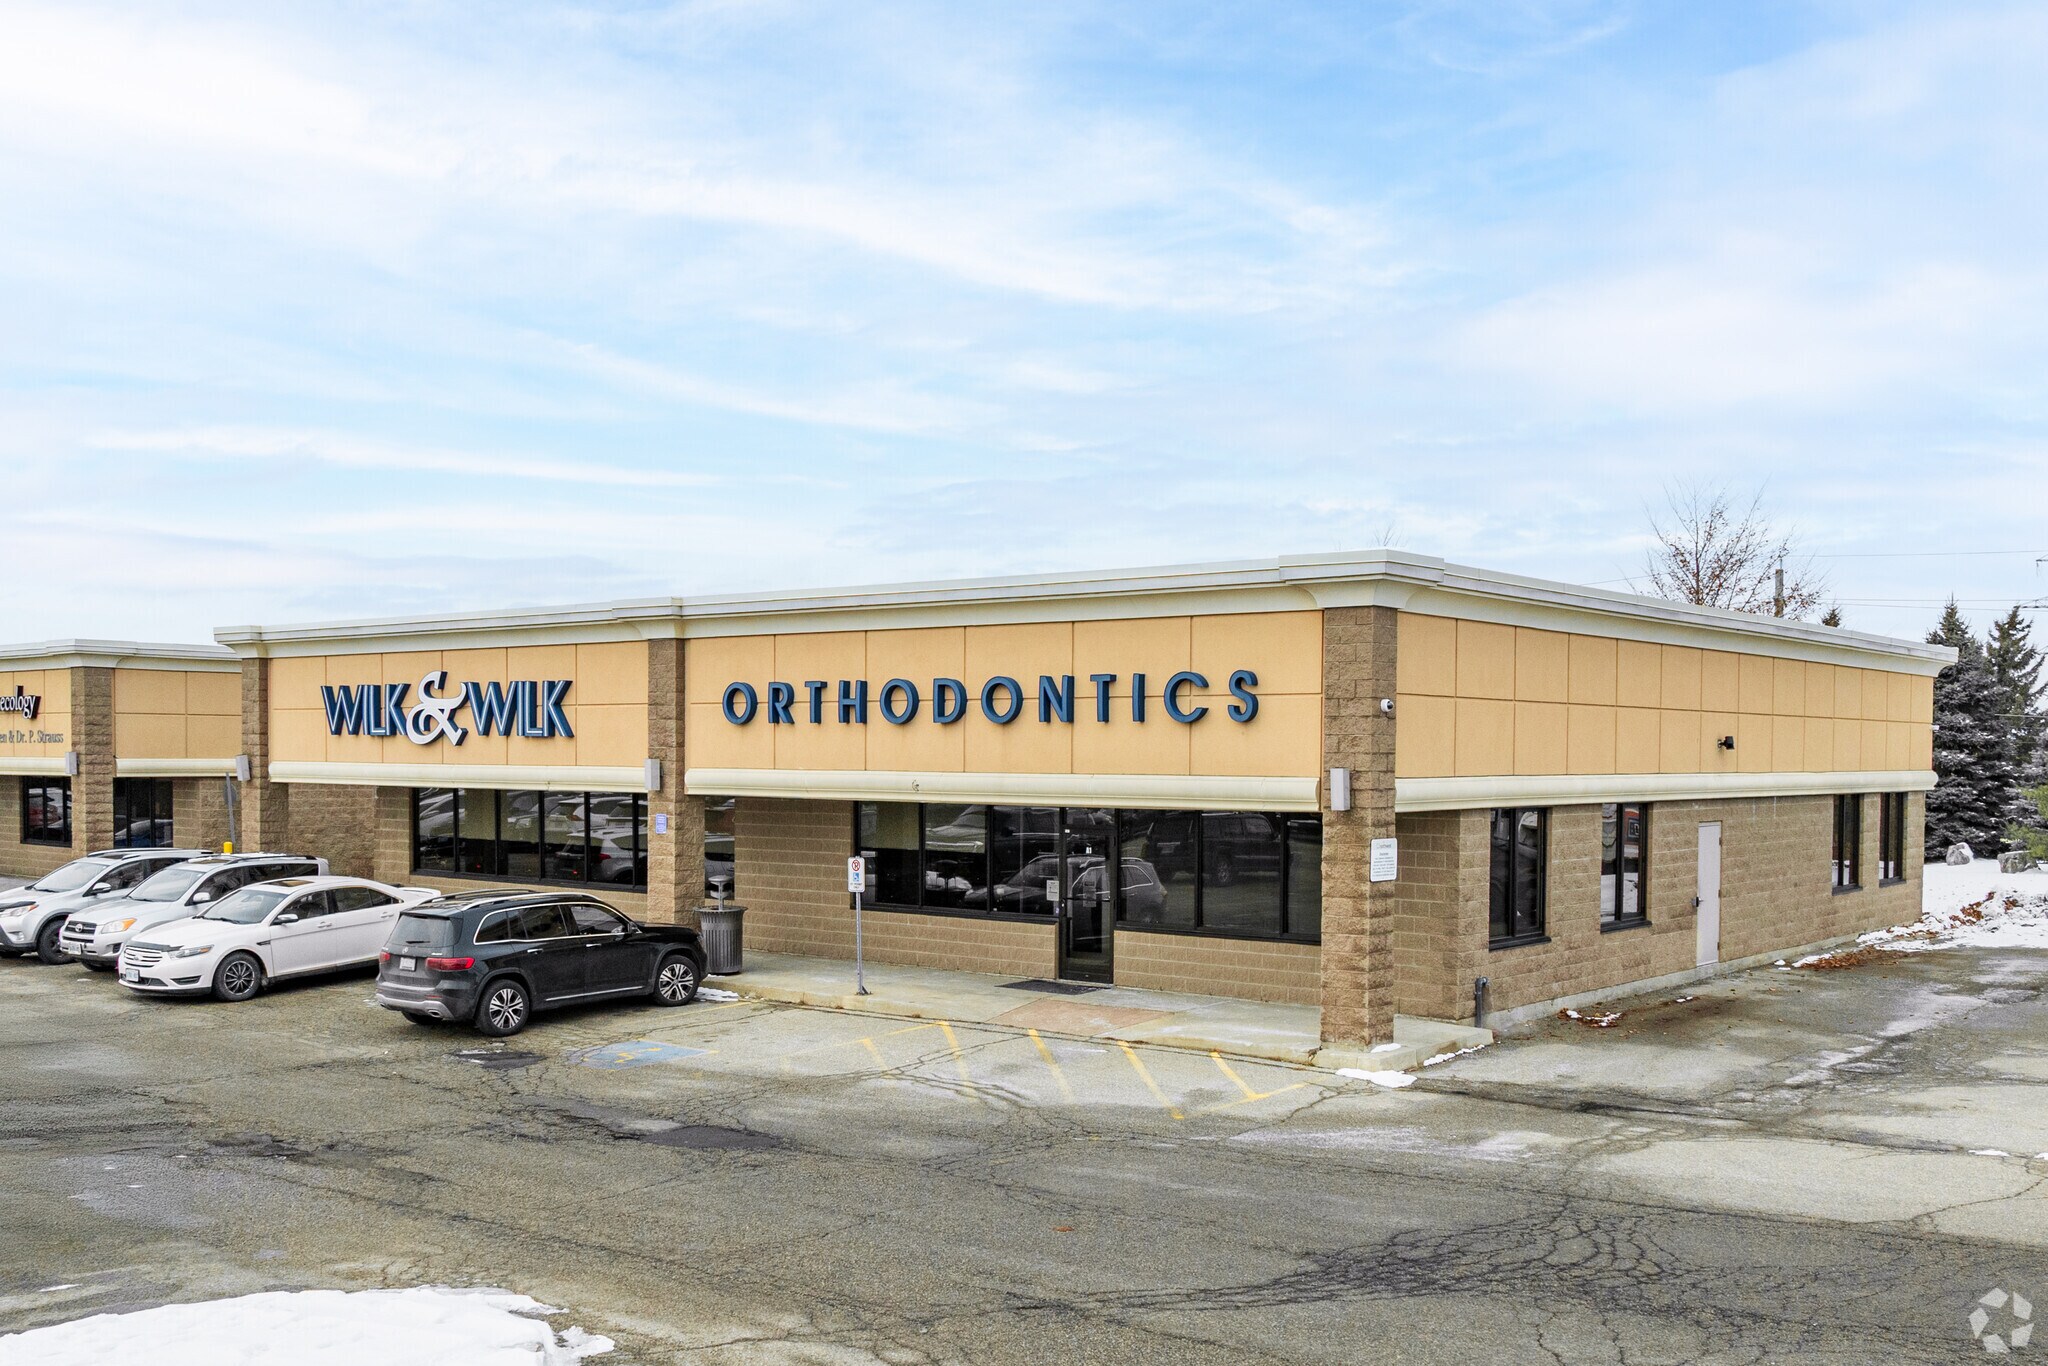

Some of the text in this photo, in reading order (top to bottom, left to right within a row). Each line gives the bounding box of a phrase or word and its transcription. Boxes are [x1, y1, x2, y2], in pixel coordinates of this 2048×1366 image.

[405, 670, 468, 746] &
[722, 669, 1259, 726] ORTHODONTICS
[17, 730, 27, 743] Dr.
[37, 730, 64, 743] Strauss
